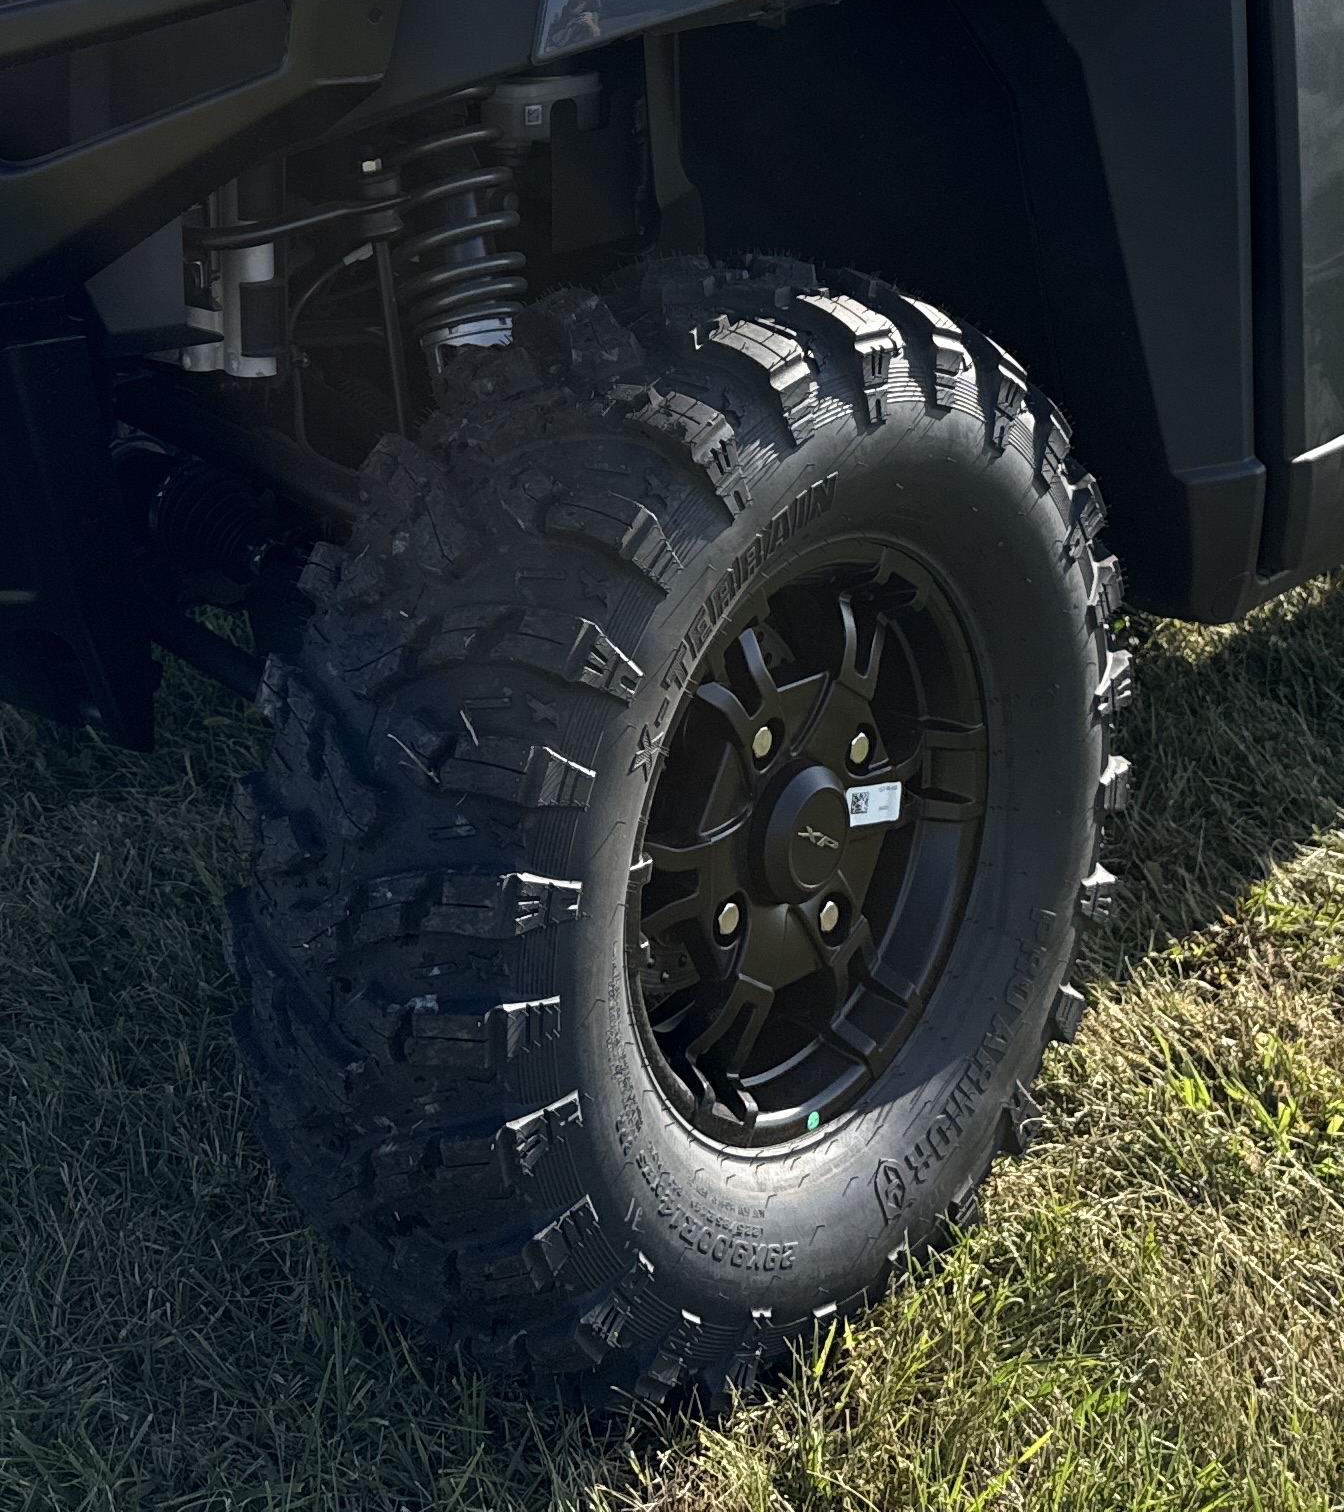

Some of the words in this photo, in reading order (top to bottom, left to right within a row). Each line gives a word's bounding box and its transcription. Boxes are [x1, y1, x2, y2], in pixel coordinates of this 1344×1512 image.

[628, 471, 839, 783] X-TERRAIN
[798, 826, 839, 849] XP
[904, 1011, 1016, 1185] ARMOR
